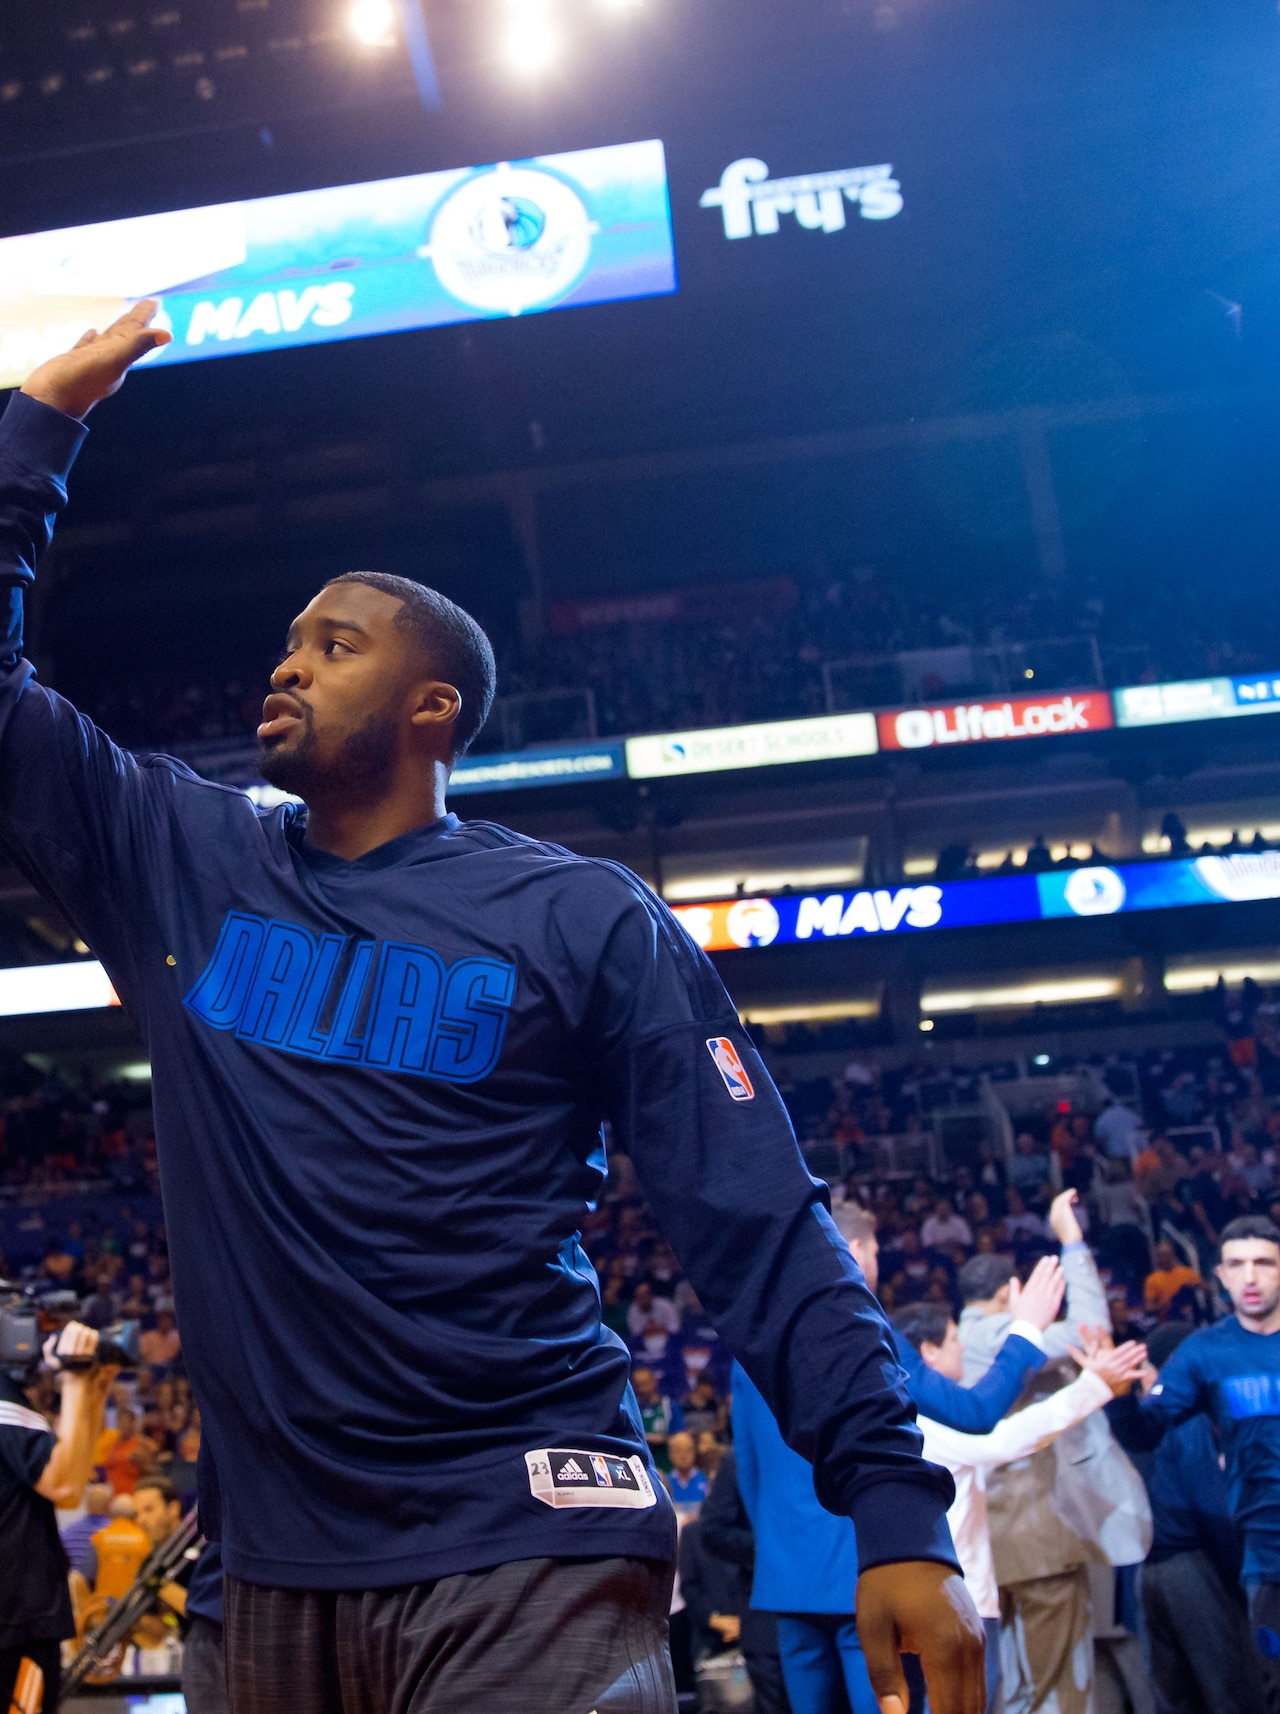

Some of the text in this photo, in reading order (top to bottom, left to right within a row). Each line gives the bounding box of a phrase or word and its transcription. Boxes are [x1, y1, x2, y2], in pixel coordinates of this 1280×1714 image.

[186, 281, 355, 346] MAVS
[795, 885, 942, 939] MAVS
[182, 909, 516, 1084] DALLAS
[530, 1461, 632, 1481] 23 adidas XL
